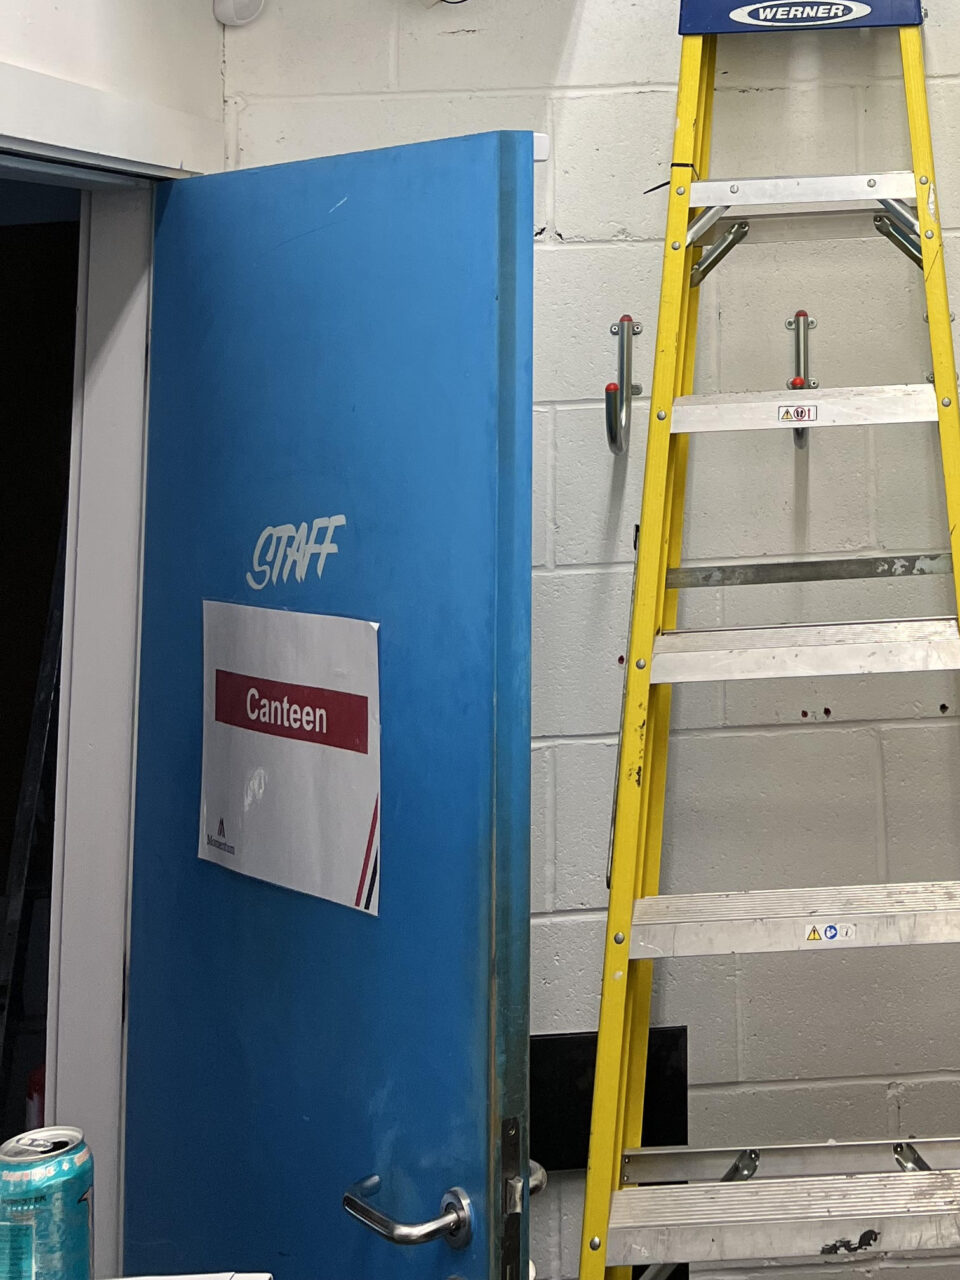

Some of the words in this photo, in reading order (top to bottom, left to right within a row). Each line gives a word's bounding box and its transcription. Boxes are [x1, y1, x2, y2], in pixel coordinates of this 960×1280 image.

[758, 4, 844, 21] WERNER
[246, 514, 347, 591] STAFF
[246, 687, 328, 734] Canteen
[206, 833, 236, 856] Momentum
